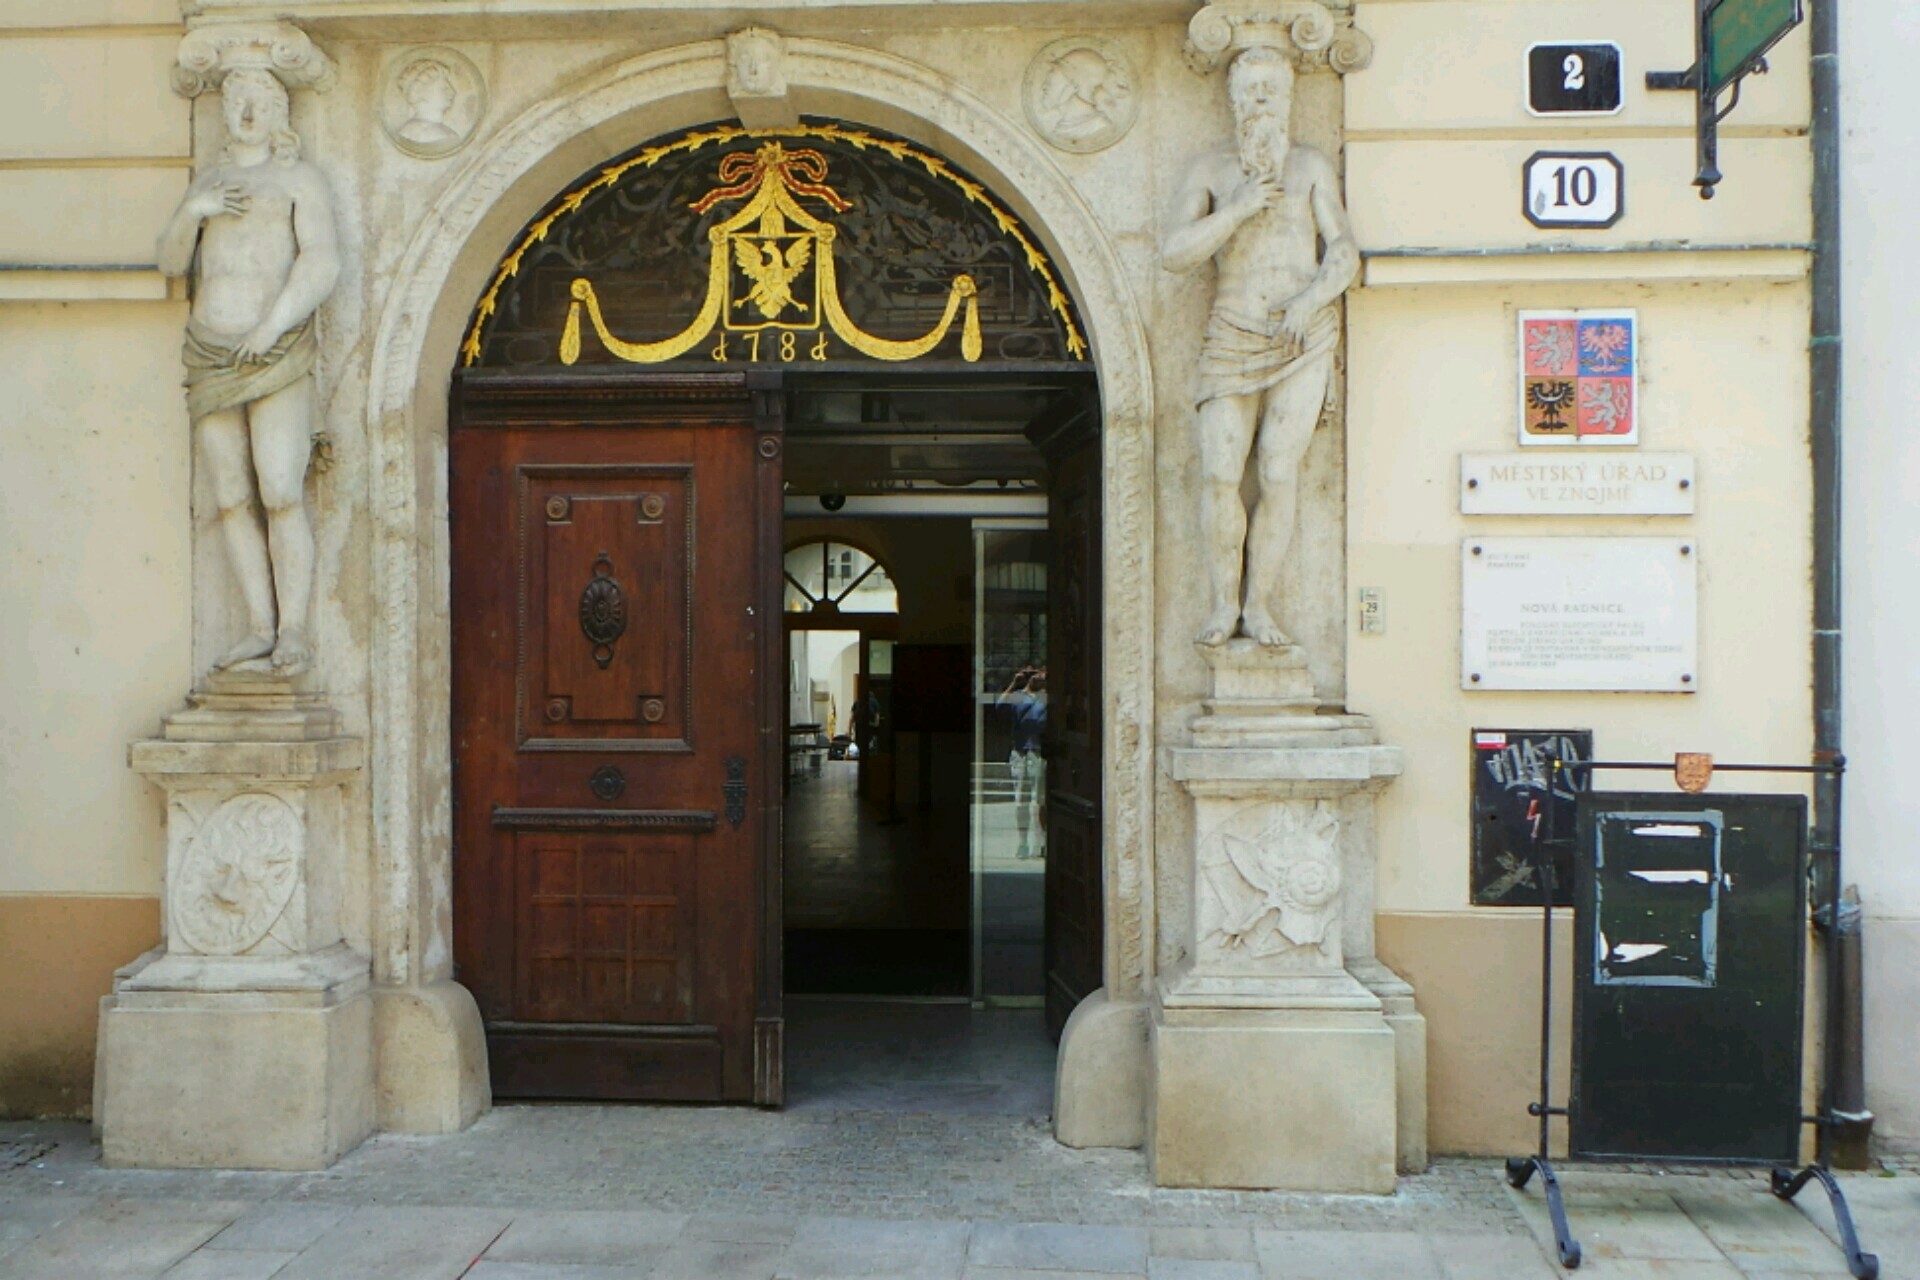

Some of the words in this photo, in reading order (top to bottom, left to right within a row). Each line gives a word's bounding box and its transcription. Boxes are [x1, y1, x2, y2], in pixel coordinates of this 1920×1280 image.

[1562, 54, 1585, 90] 2
[1551, 165, 1597, 206] 10
[1490, 461, 1587, 482] MĚSTSKÝ
[1600, 461, 1667, 482] ÚŘAD
[1526, 487, 1549, 500] VE
